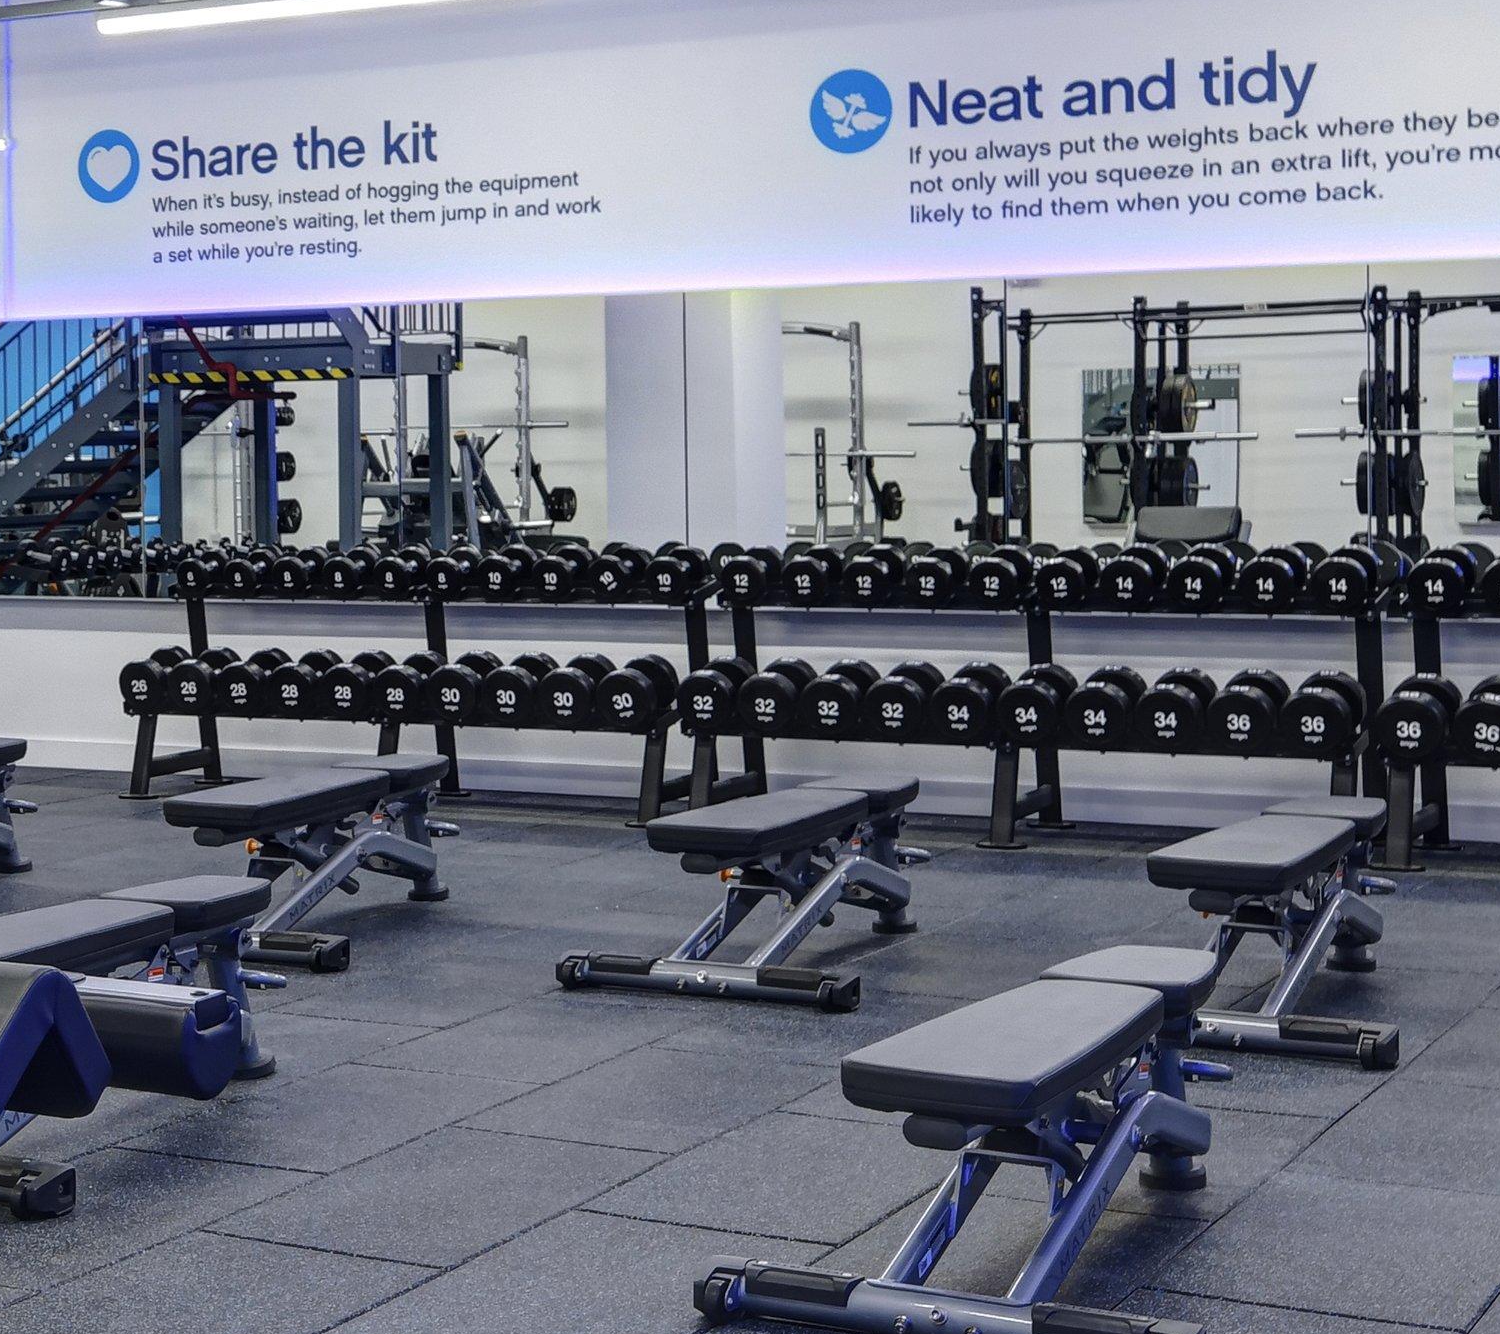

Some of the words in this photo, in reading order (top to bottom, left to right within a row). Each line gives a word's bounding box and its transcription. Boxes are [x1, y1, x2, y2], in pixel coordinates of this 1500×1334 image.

[909, 75, 1043, 128] Neat
[1063, 58, 1175, 117] and
[1199, 49, 1317, 119] tidy
[909, 145, 922, 165] If
[928, 147, 968, 170] you
[975, 140, 1052, 163] always
[1059, 135, 1096, 161] put
[1102, 131, 1140, 153] the
[1146, 125, 1239, 154] weights
[1248, 118, 1309, 143] back
[1316, 116, 1395, 139] where
[1402, 110, 1458, 137] they
[151, 136, 278, 181] Share
[293, 126, 365, 170] the
[384, 120, 437, 165] kit
[909, 175, 944, 195] not
[951, 170, 997, 196] only
[1003, 167, 1040, 189] will
[1047, 170, 1088, 193] you
[1095, 162, 1195, 189] squeeze
[1202, 157, 1223, 178] in
[1230, 159, 1260, 176] an
[1270, 153, 1332, 173] extra
[1341, 147, 1377, 172] lift,
[1384, 143, 1462, 173] you're
[151, 195, 198, 213] When
[203, 192, 226, 210] it's
[230, 190, 273, 212] busy,
[277, 183, 340, 205] instead
[345, 182, 362, 201] of
[367, 180, 440, 204] hogging
[444, 176, 474, 195] the
[478, 170, 580, 197] equipment
[910, 202, 965, 228] likely
[971, 203, 993, 221] to
[1000, 197, 1043, 219] find
[1050, 196, 1109, 217] them
[1116, 191, 1180, 213] when
[1187, 192, 1230, 216] you
[1238, 187, 1307, 207] come
[1315, 178, 1384, 203] back.
[151, 219, 195, 239] while
[199, 214, 288, 236] someone's
[292, 211, 359, 233] waiting,
[363, 208, 386, 226] let
[389, 206, 436, 225] them
[440, 205, 487, 227] jump
[492, 202, 509, 219] in
[514, 197, 550, 218] and
[555, 195, 602, 215] work
[152, 251, 163, 264] a
[168, 246, 193, 263] set
[196, 242, 241, 261] while
[244, 241, 295, 264] you're
[299, 237, 363, 259] resting.
[543, 572, 558, 585] 10
[733, 573, 749, 587] 12
[983, 576, 1000, 590] 12
[1184, 576, 1203, 592] 14
[1424, 578, 1445, 595] 14
[130, 679, 148, 693] 26
[180, 681, 198, 695] 26
[229, 682, 248, 697] 28
[281, 684, 299, 699] 28
[334, 685, 352, 700] 28
[386, 687, 405, 702] 28
[440, 687, 461, 703] 30
[496, 689, 516, 706] 30
[553, 691, 574, 707] 30
[611, 692, 633, 710] 30
[693, 695, 714, 711] 32
[754, 697, 776, 714] 32
[817, 700, 839, 717] 32
[881, 702, 904, 719] 32
[947, 704, 970, 721] 34
[1014, 706, 1038, 724] 34
[1083, 708, 1107, 726] 34
[1154, 711, 1178, 729] 34
[1226, 713, 1251, 732] 36
[1300, 715, 1325, 734] 36
[1396, 720, 1422, 739] 36
[1473, 722, 1500, 743] 36
[288, 873, 336, 921] MATRIX
